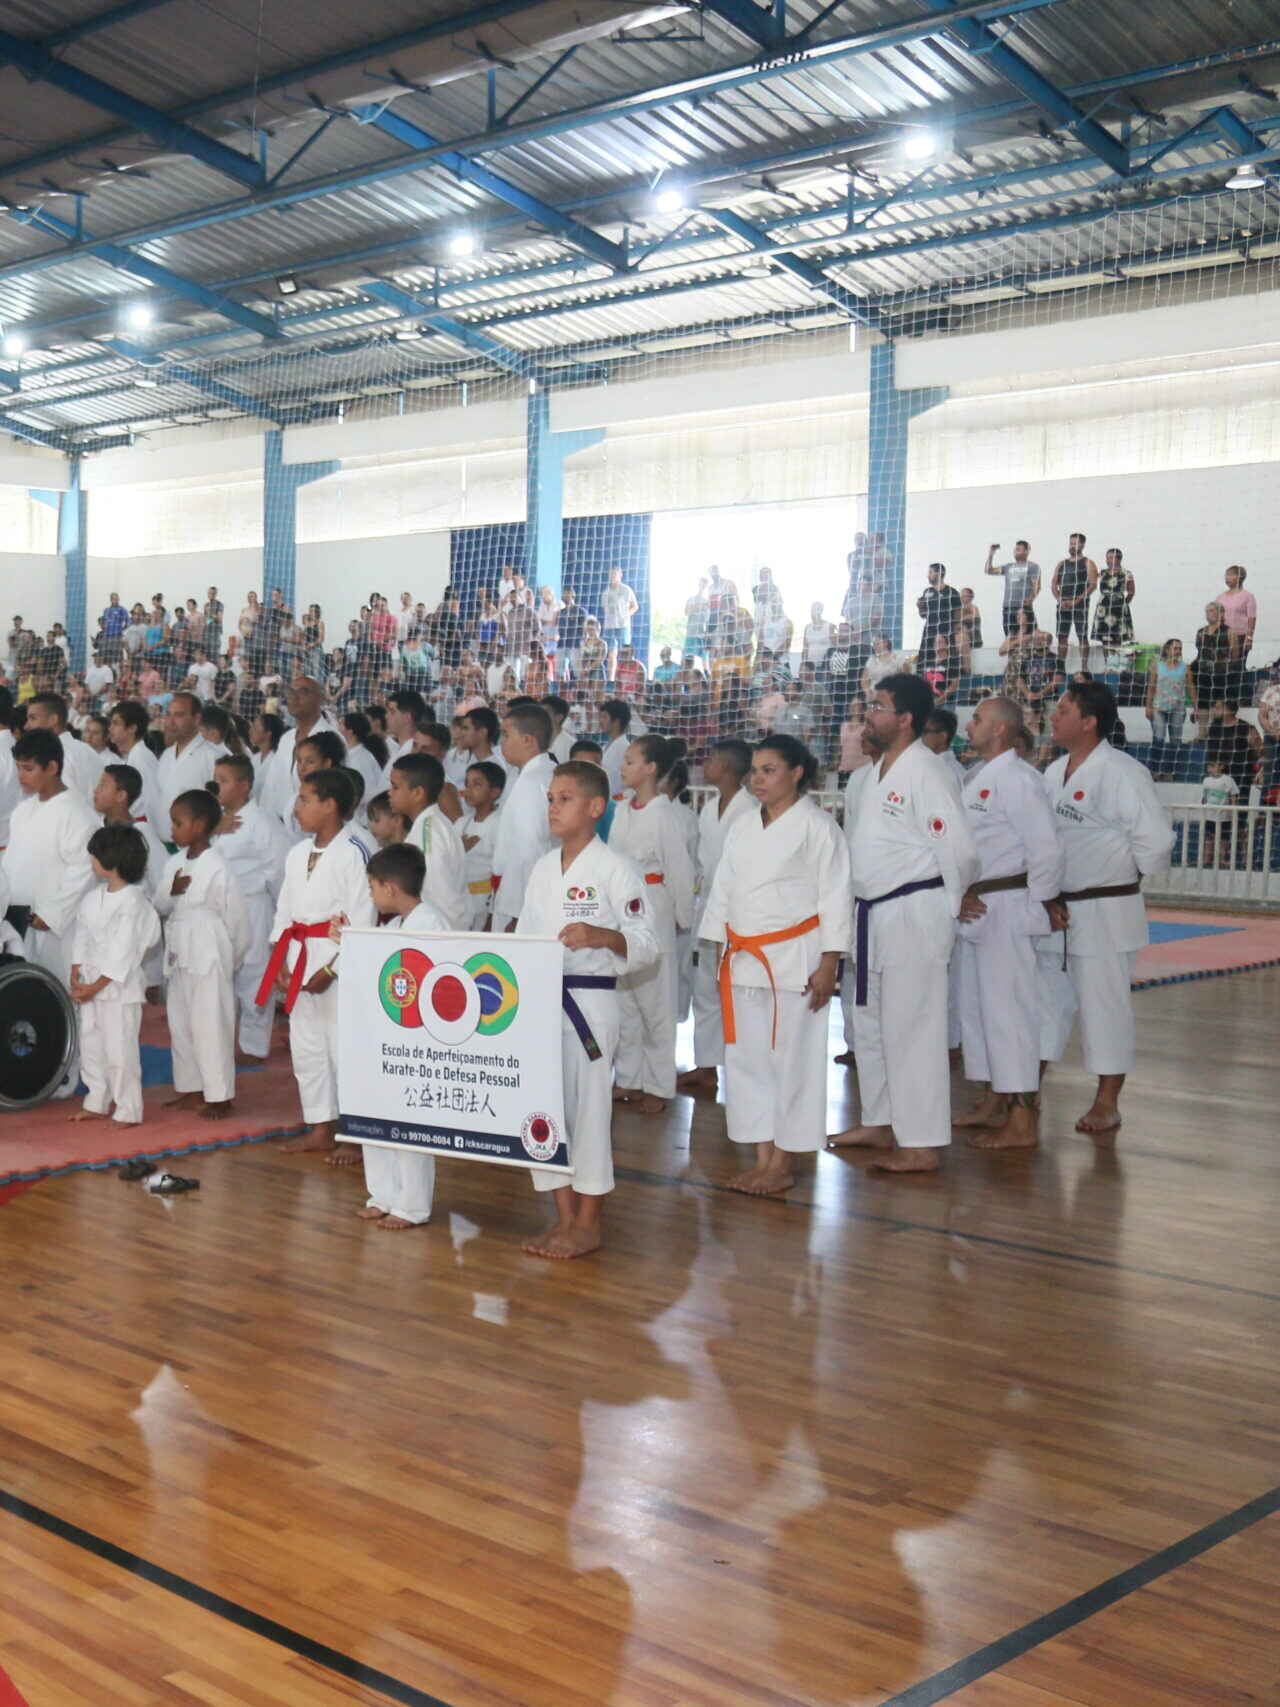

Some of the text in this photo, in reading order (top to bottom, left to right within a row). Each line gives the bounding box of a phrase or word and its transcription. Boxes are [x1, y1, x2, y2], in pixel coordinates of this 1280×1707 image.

[382, 1043, 520, 1069] Escola de Aperfeiçoamento do
[382, 1061, 520, 1088] Karate-Do e Defesa Pessoal
